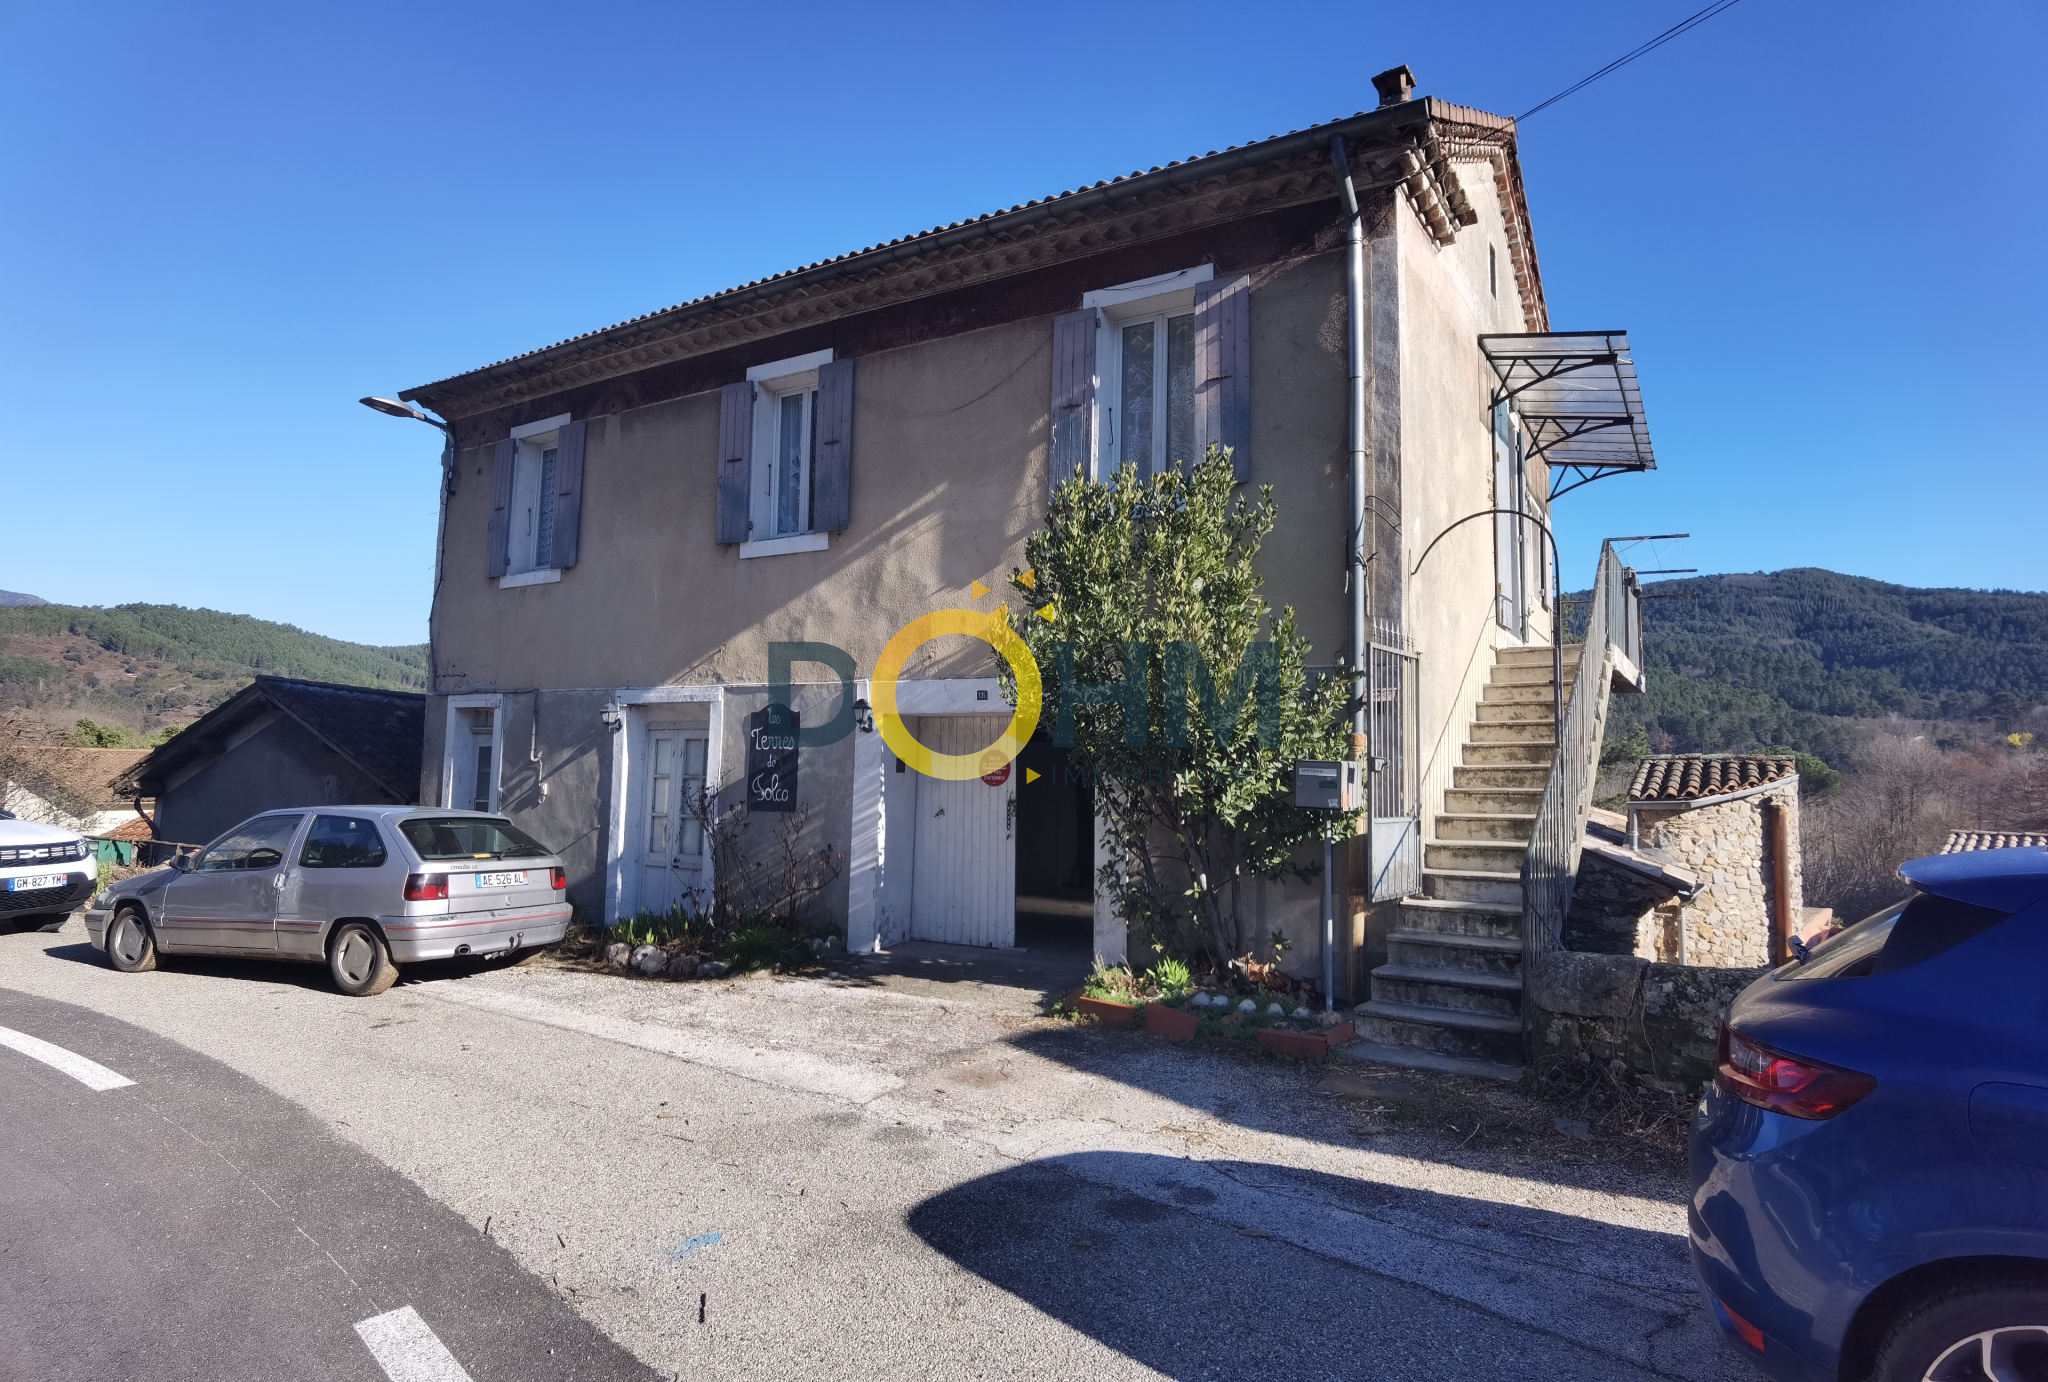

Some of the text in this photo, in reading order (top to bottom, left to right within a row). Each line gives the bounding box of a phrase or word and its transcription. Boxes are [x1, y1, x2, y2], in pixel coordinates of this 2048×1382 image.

[751, 726, 795, 751] Terres
[767, 754, 777, 768] de
[483, 871, 524, 886] AE-526-AL
